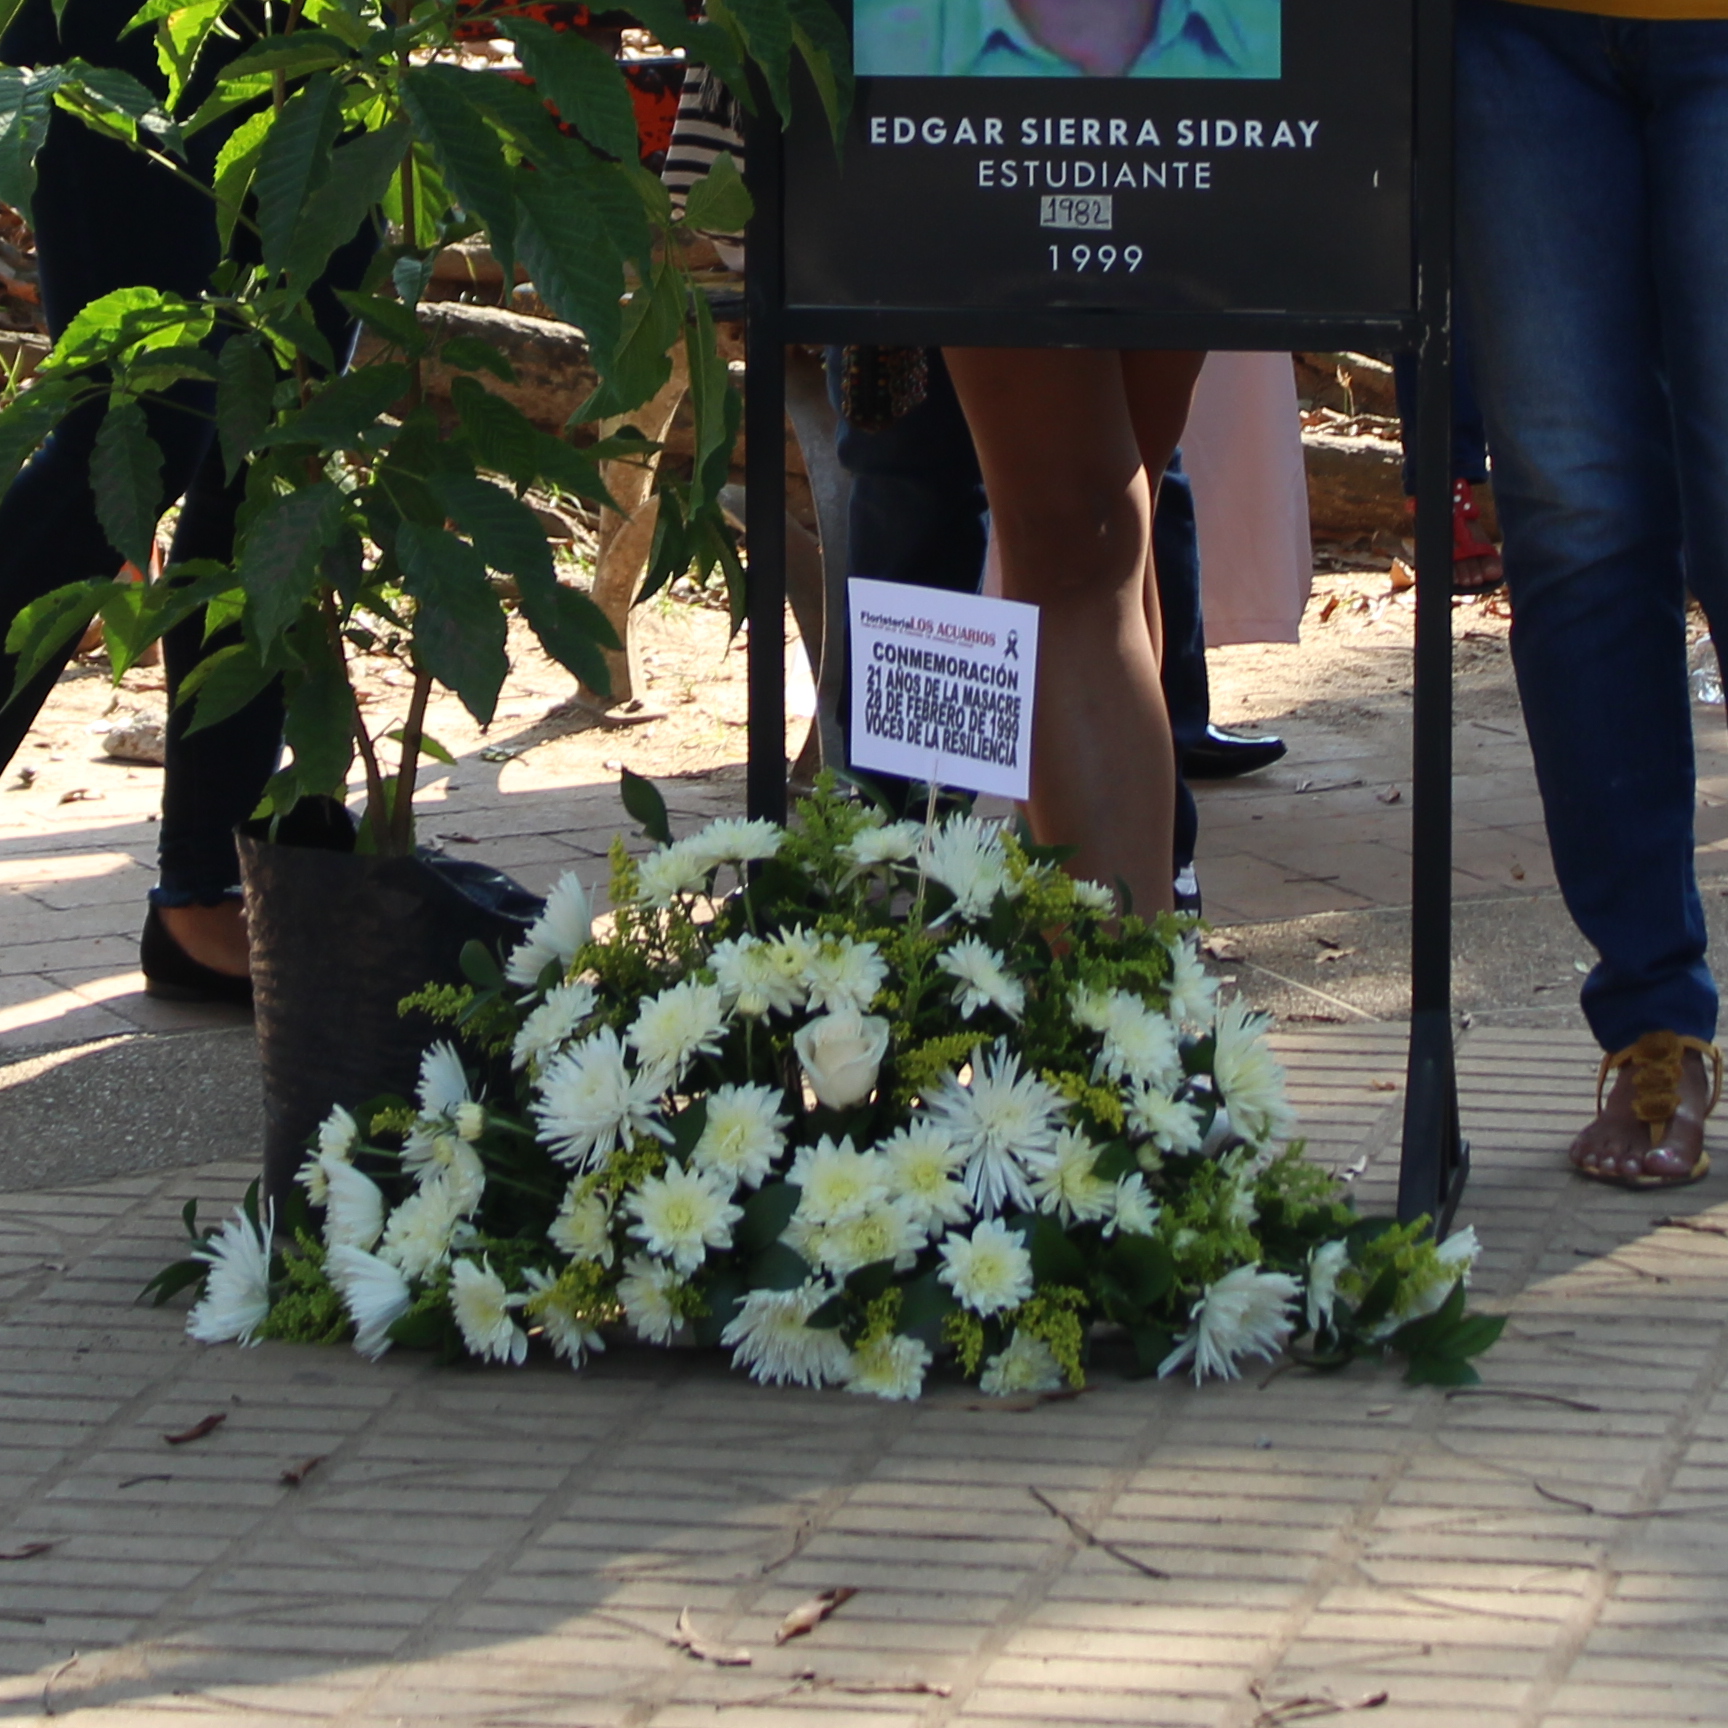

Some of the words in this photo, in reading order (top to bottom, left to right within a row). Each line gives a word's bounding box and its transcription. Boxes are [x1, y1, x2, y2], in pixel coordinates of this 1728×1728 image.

[871, 116, 1004, 145] EDGAR
[1020, 117, 1161, 146] SIERRA
[1177, 119, 1319, 148] SIDRAY
[978, 159, 1211, 189] ESTUDIANTE
[1043, 197, 1109, 225] 1982
[1048, 244, 1143, 272] 1999
[937, 622, 996, 647] ACUARIOS
[873, 641, 1019, 691] CONMEMORACIÓN
[867, 664, 882, 688] 21
[886, 665, 921, 696] AÑOS
[924, 676, 941, 701] DE
[943, 680, 958, 705] LA
[963, 685, 1021, 720] MASACRE
[866, 686, 882, 713] 28
[886, 690, 903, 716] DE
[906, 694, 965, 730] FEBRERO
[969, 708, 986, 735] DE
[990, 713, 1019, 743] 1999
[865, 708, 904, 743] VOCES
[907, 720, 922, 746] DE
[924, 724, 939, 750] LA
[943, 728, 1017, 768] RESILIENCIA
